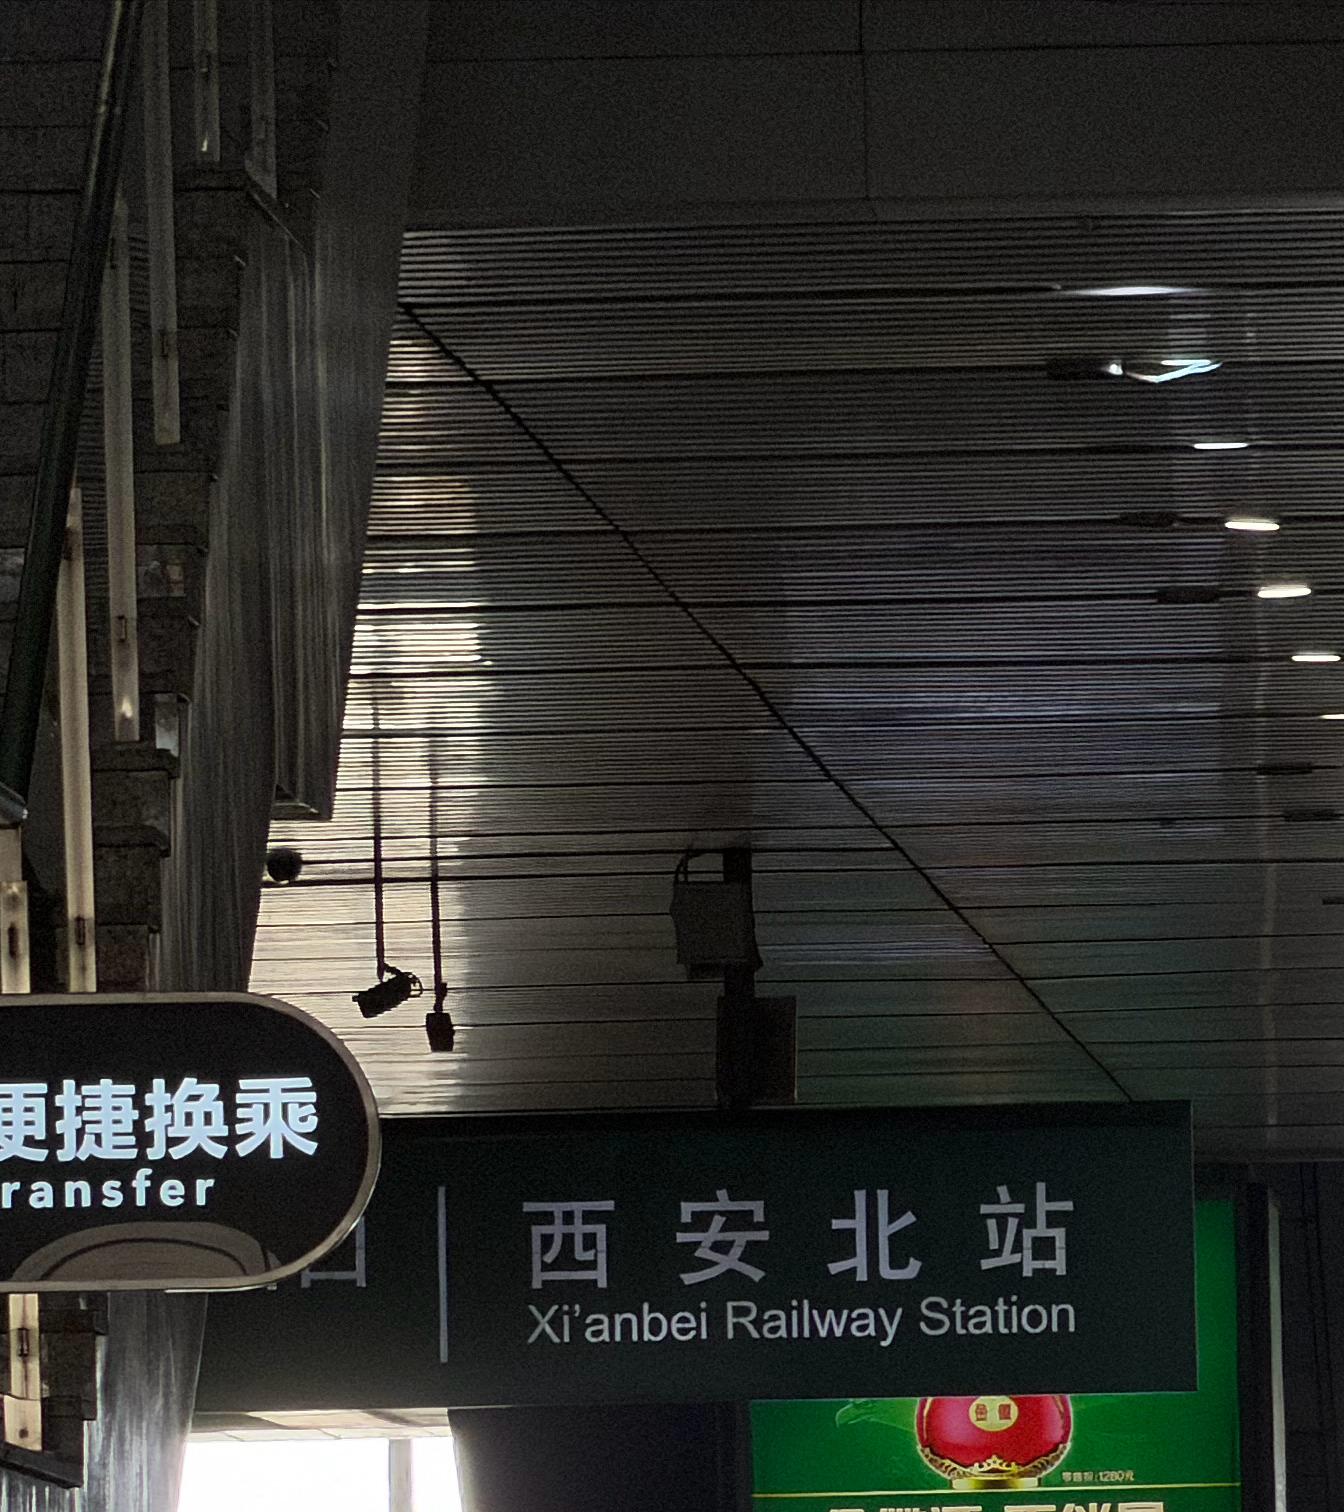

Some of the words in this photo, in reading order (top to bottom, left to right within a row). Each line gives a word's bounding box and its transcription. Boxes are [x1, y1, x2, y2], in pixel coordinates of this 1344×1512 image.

[522, 1181, 1075, 1289] 西安北站
[726, 1299, 902, 1347] Railway
[919, 1295, 1076, 1337] Station
